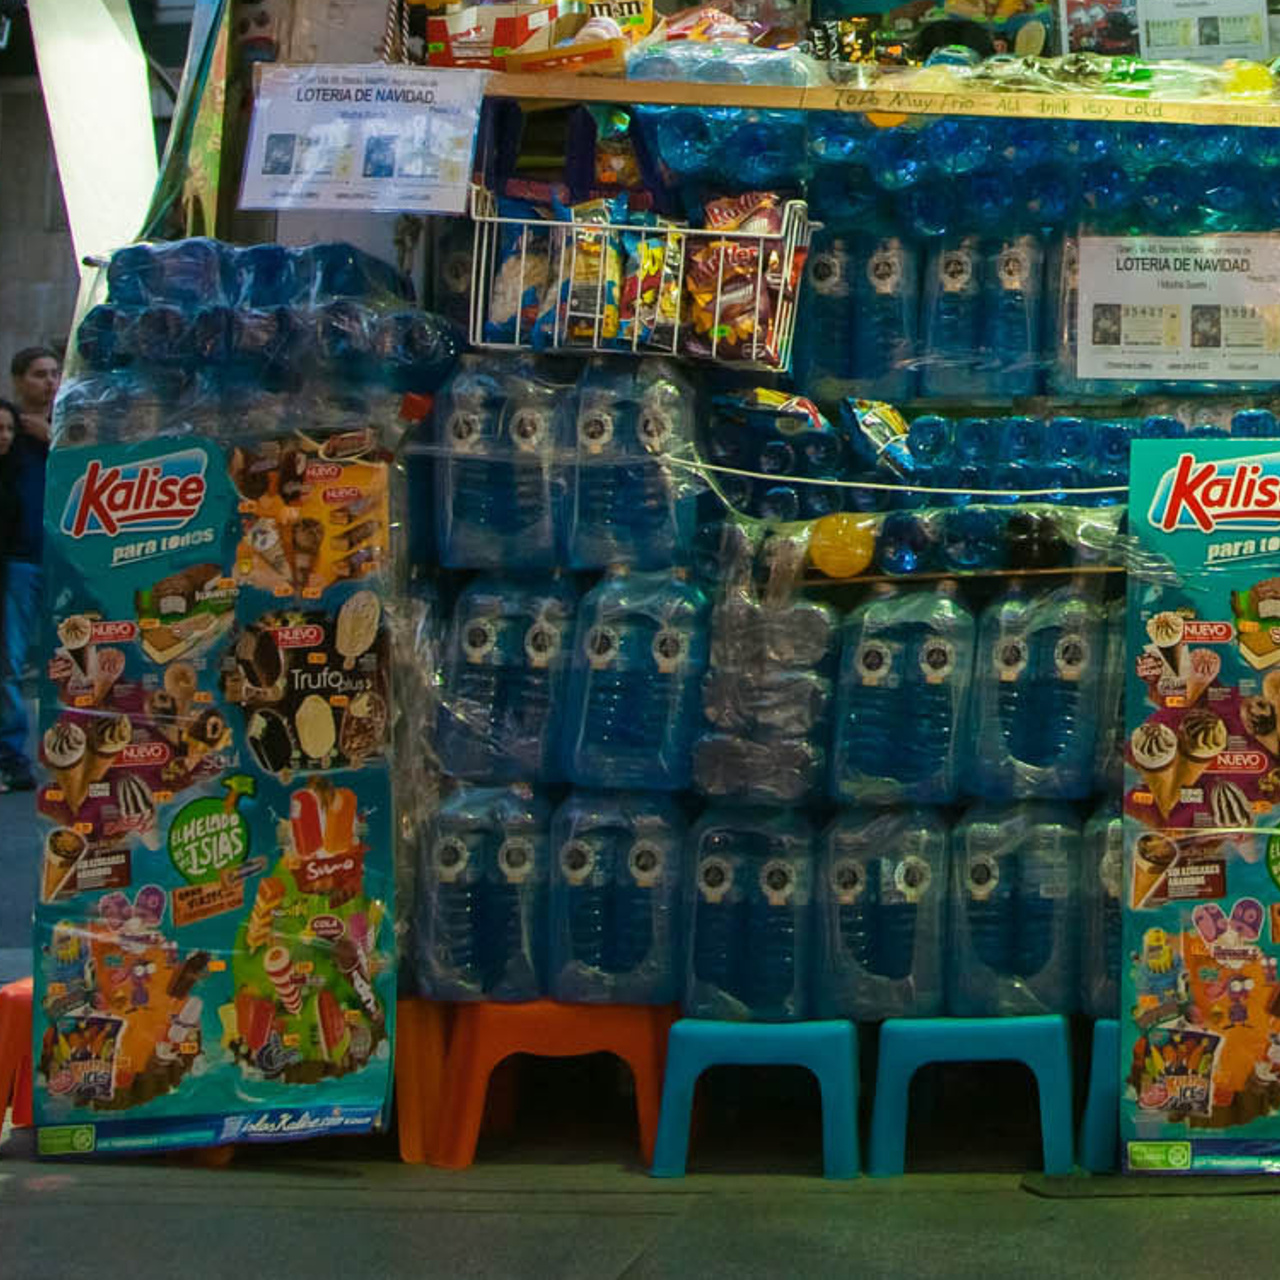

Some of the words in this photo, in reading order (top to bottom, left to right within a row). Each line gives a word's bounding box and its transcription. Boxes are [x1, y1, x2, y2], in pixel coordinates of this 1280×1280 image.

[296, 87, 351, 103] LOTERIA
[354, 88, 372, 103] DE
[1116, 257, 1172, 272] LOTERIA
[1173, 257, 1191, 272] DE
[1193, 257, 1251, 273] NAVIDAD
[73, 460, 206, 537] Kalise
[112, 539, 158, 564] para
[1207, 539, 1256, 562] para
[92, 623, 131, 636] NUEVO
[278, 628, 317, 641] NUEVO
[1186, 624, 1227, 638] NUEVO
[291, 668, 343, 690] Trufo
[122, 746, 162, 760] NUEVO
[1217, 753, 1260, 767] NUEVO
[185, 827, 243, 875] ISLAS
